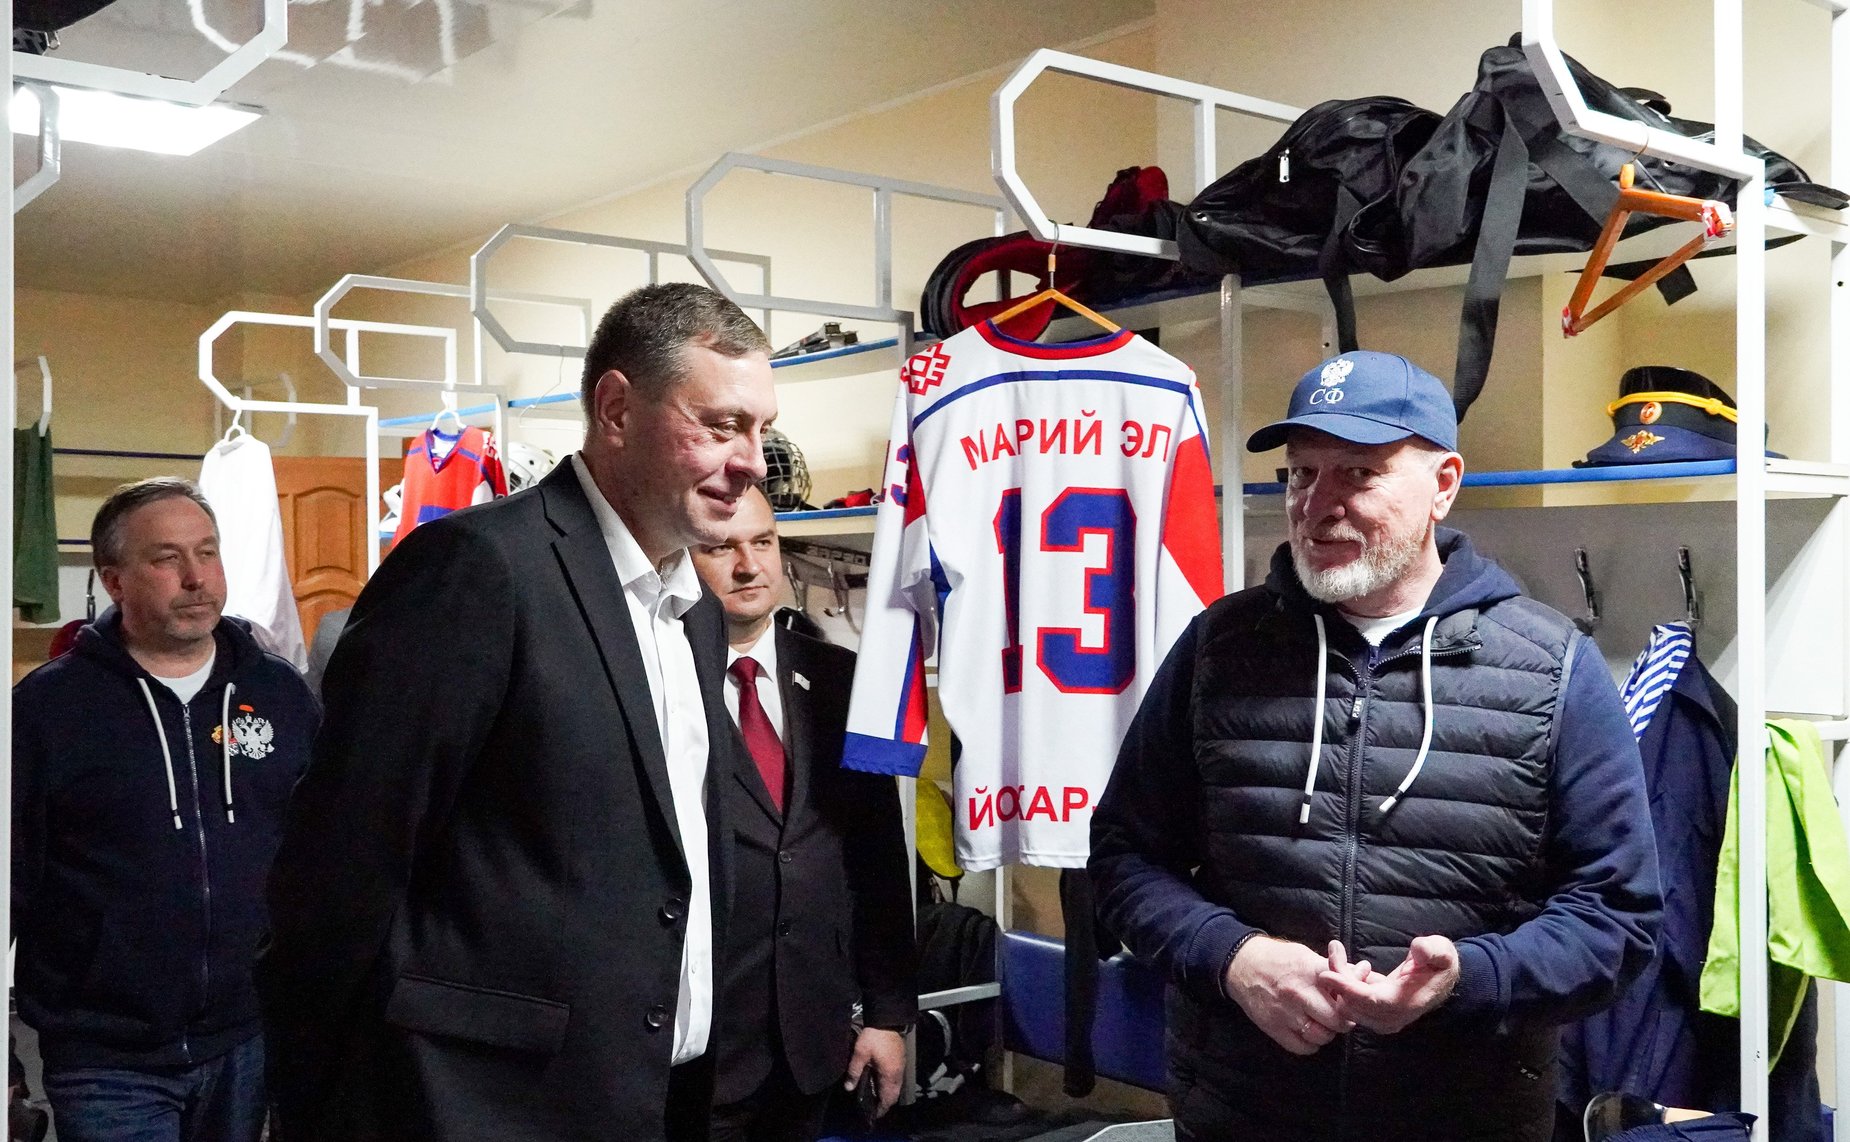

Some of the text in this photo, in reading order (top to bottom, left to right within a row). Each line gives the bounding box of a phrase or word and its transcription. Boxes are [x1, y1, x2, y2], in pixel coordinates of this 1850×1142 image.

[1309, 387, 1344, 405] СФ
[960, 409, 1171, 470] МАРИЙ ЭЛ
[993, 486, 1137, 694] 13
